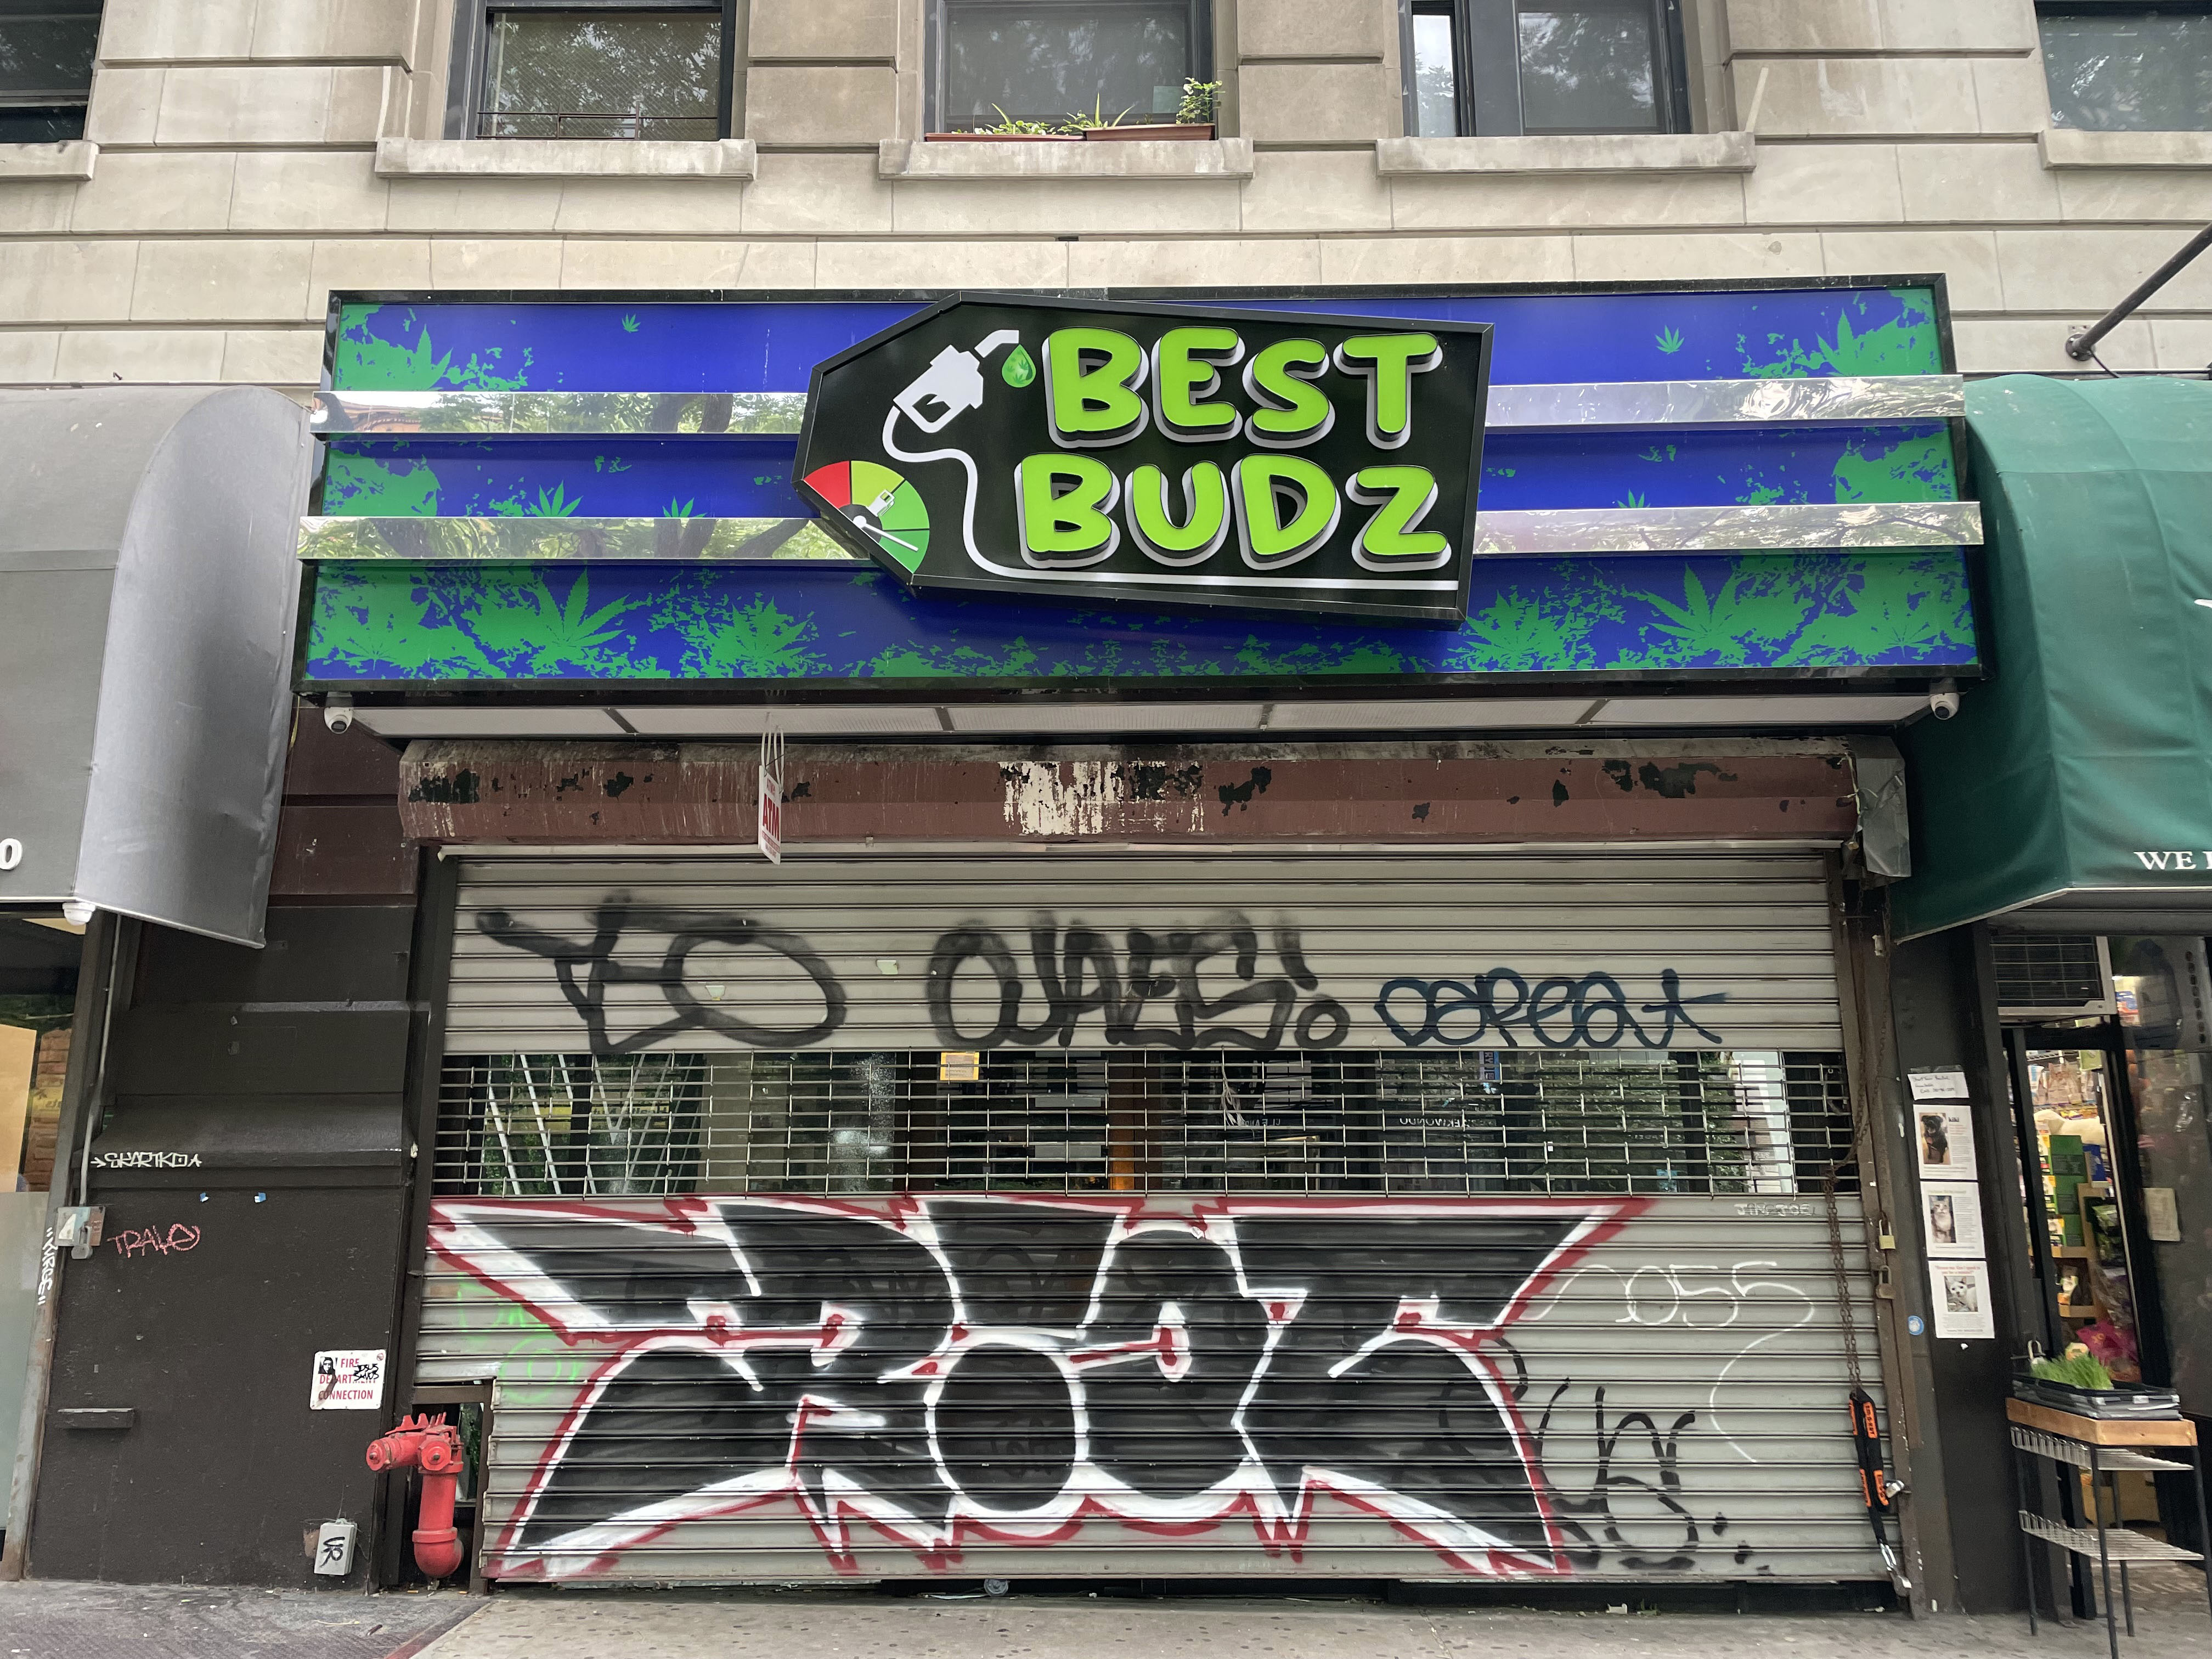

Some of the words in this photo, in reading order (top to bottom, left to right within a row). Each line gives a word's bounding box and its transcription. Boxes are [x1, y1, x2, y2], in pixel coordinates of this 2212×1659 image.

[1042, 325, 1444, 449] BEST
[1015, 452, 1453, 572] BUDZ
[763, 793, 780, 842] ATM
[2133, 851, 2197, 870] WE
[341, 1358, 360, 1368] FIRE
[318, 1390, 374, 1401] CONNECTION
